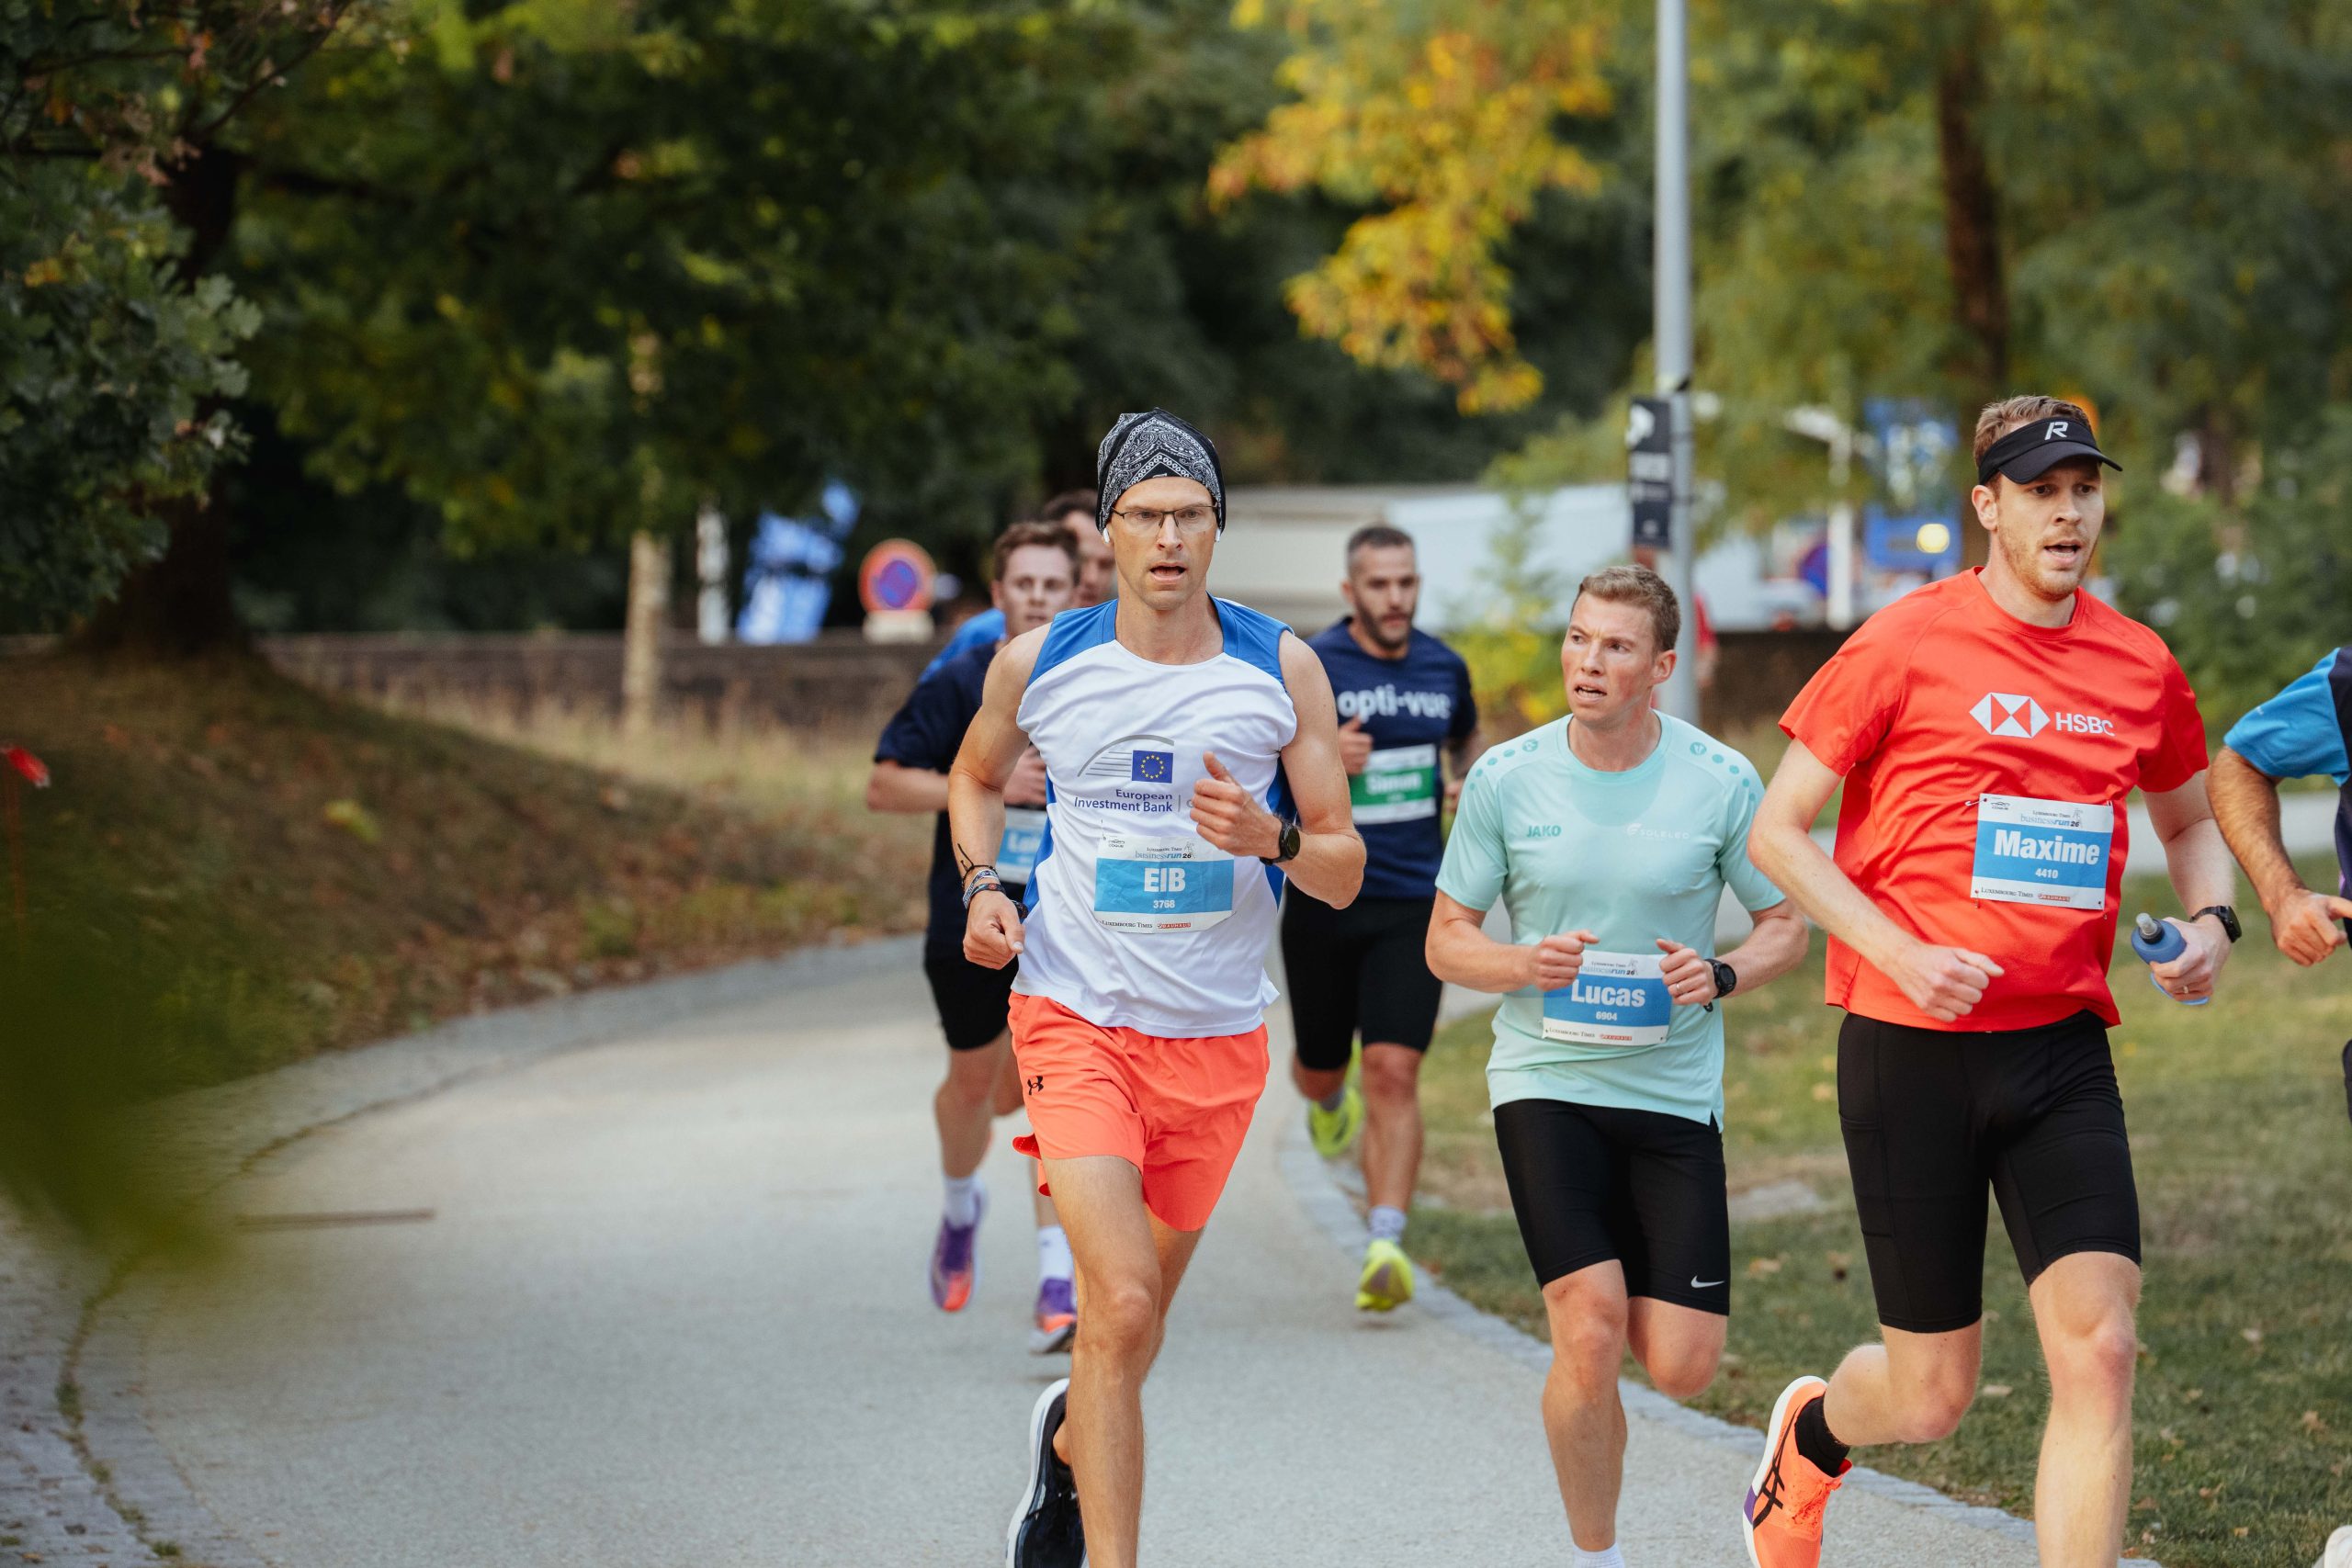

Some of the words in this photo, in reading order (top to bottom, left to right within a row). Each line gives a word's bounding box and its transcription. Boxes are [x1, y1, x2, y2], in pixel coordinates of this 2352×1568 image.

[2055, 711, 2116, 737] HSBC
[1074, 796, 1140, 812] Investment
[1143, 801, 1173, 812] Bank
[1115, 788, 1172, 801] European
[1526, 825, 1562, 838] JAKO
[1994, 829, 2100, 865] Maxime
[1144, 867, 1186, 893] EIB
[2035, 868, 2059, 879] 4410
[1571, 978, 1646, 1008] Lucas
